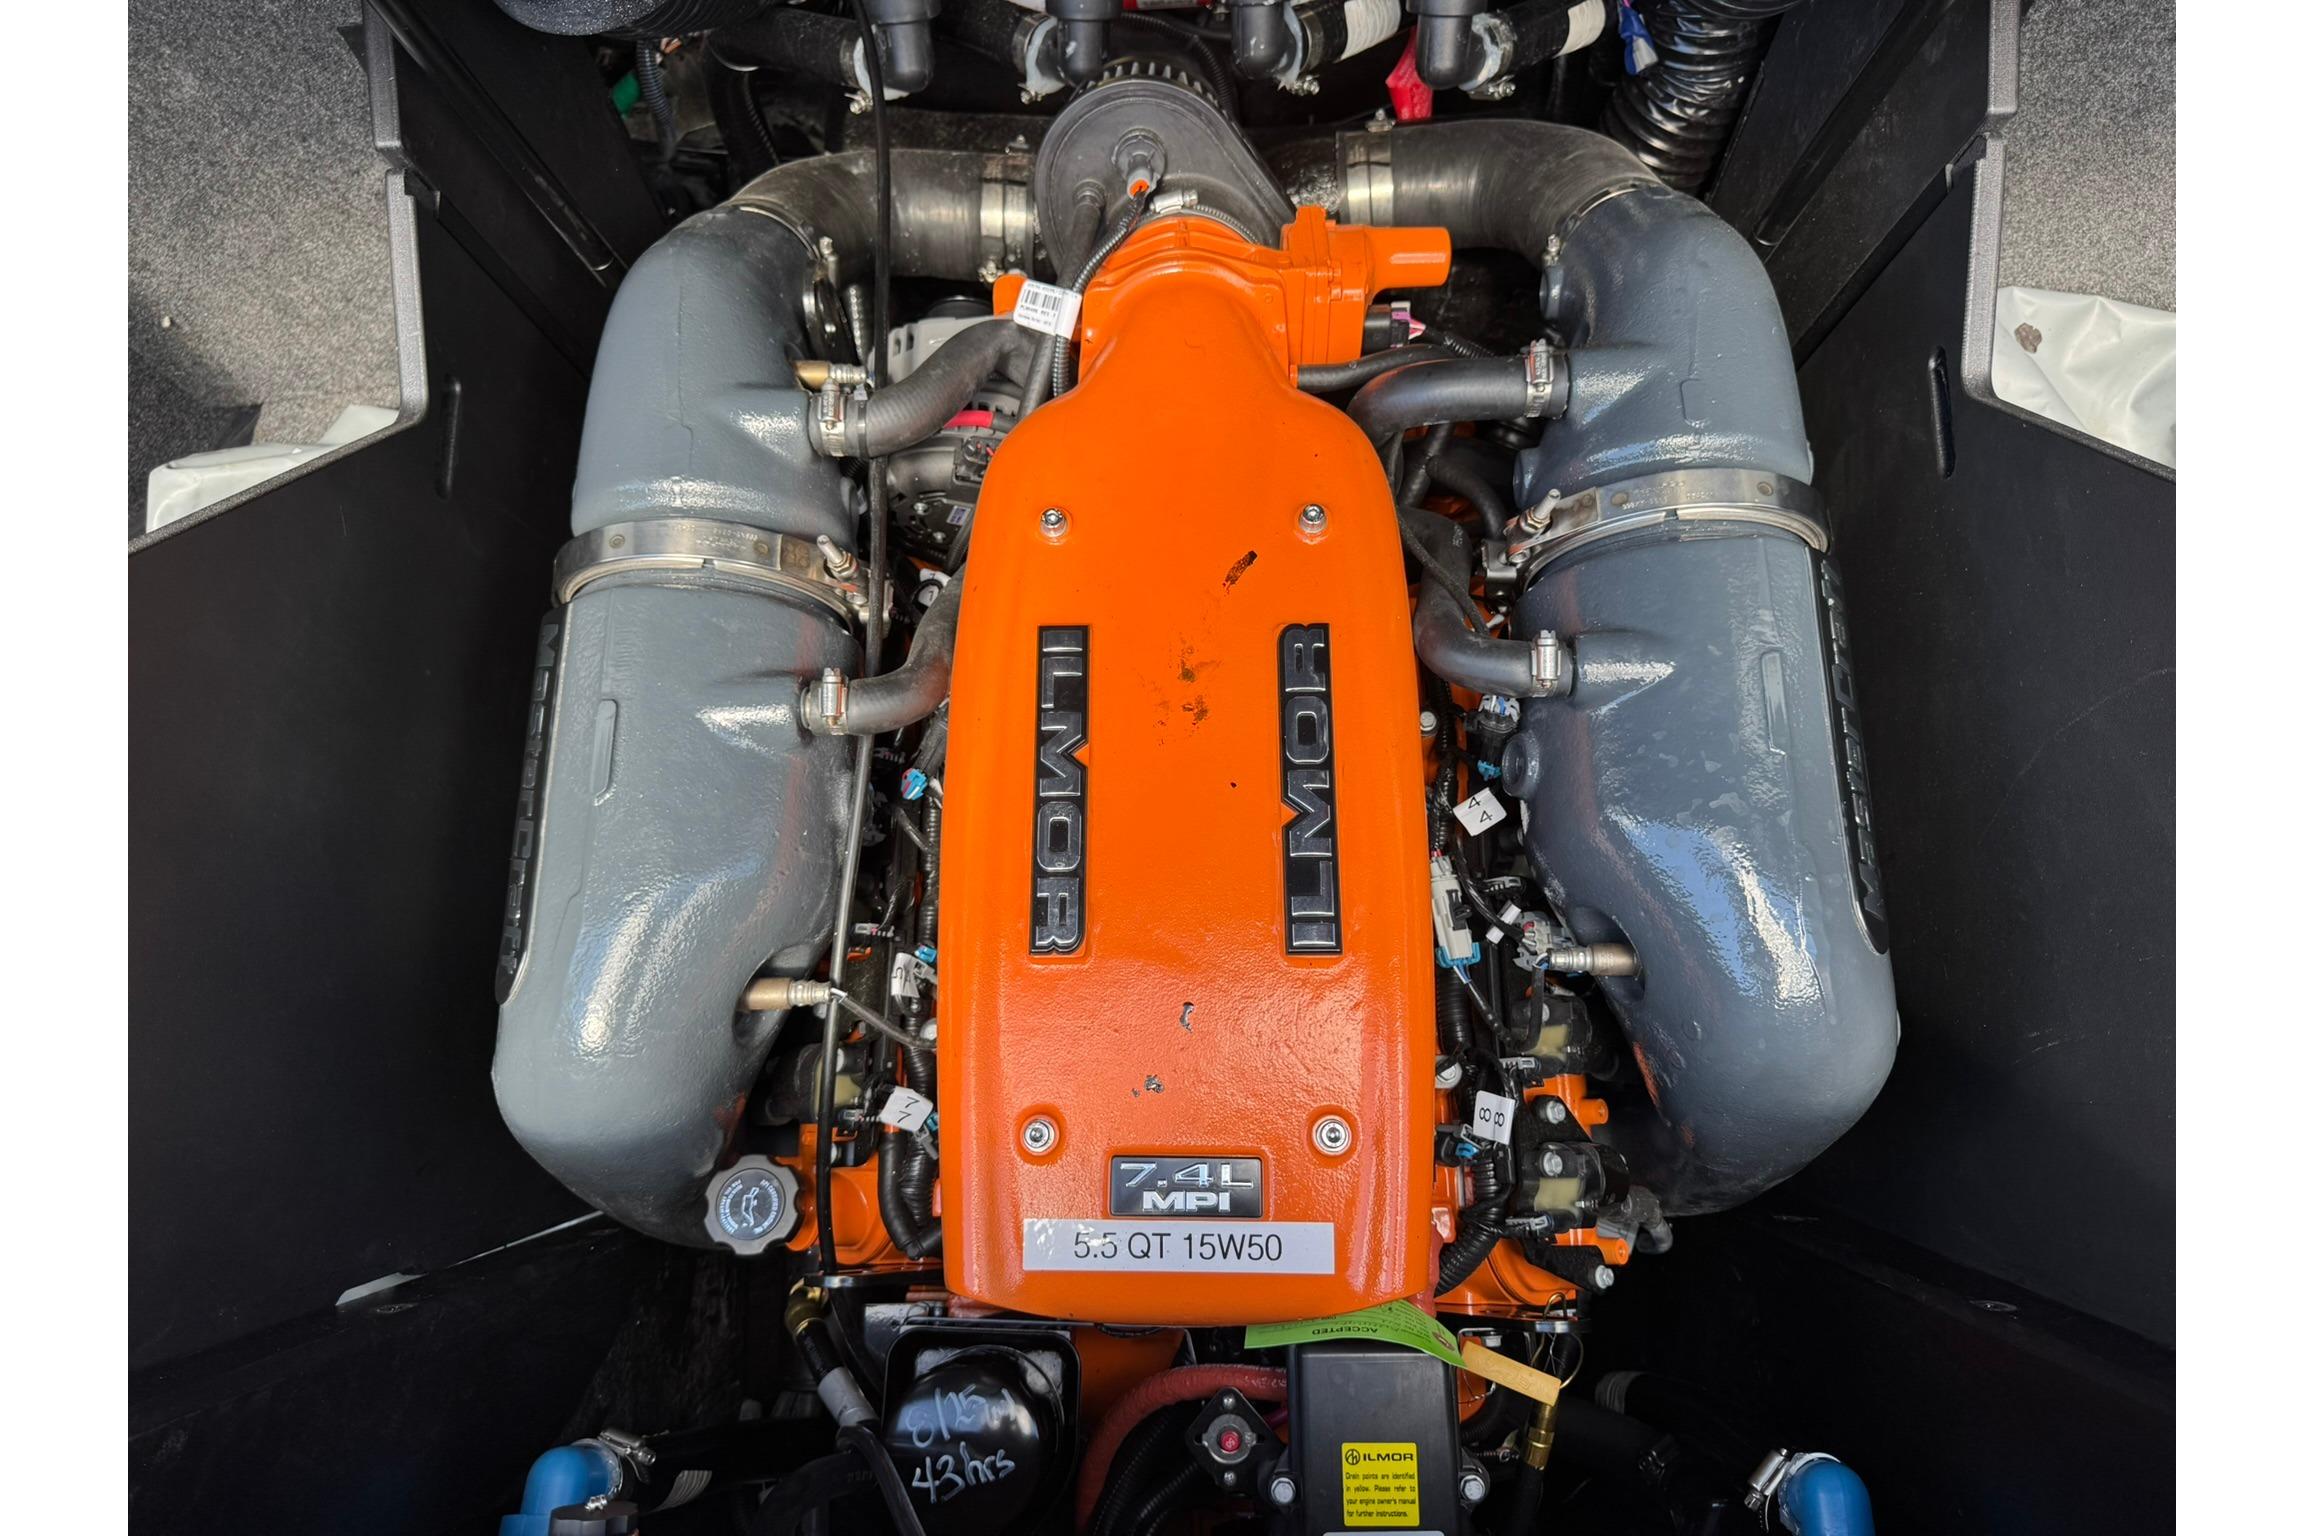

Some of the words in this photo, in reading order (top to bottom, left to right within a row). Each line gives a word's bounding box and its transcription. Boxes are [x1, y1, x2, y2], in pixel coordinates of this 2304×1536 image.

[1035, 628, 1084, 948] ILMOR
[1284, 627, 1337, 948] ILMOR
[1467, 796, 1482, 810] 4
[1479, 810, 1494, 824] 4
[905, 1095, 921, 1109] 7
[896, 1110, 912, 1124] 7
[1479, 1107, 1492, 1123] 8
[1493, 1111, 1506, 1128] 8
[1119, 1161, 1254, 1189] 7.4L
[1142, 1190, 1232, 1213] MPI
[1073, 1231, 1119, 1260] 5.5
[1127, 1231, 1172, 1260] QT
[1183, 1232, 1283, 1262] 15W50
[1311, 1325, 1379, 1336] ACCEPTED
[1363, 1452, 1414, 1462] ILMOR
[1345, 1472, 1360, 1480] Drain
[1362, 1472, 1378, 1481] points
[1392, 1471, 1415, 1480] identified
[1374, 1484, 1391, 1492] Please
[1346, 1498, 1358, 1506] your
[1360, 1498, 1375, 1506] engine
[1377, 1497, 1397, 1505] owner's
[1376, 1510, 1408, 1518] instructions.
